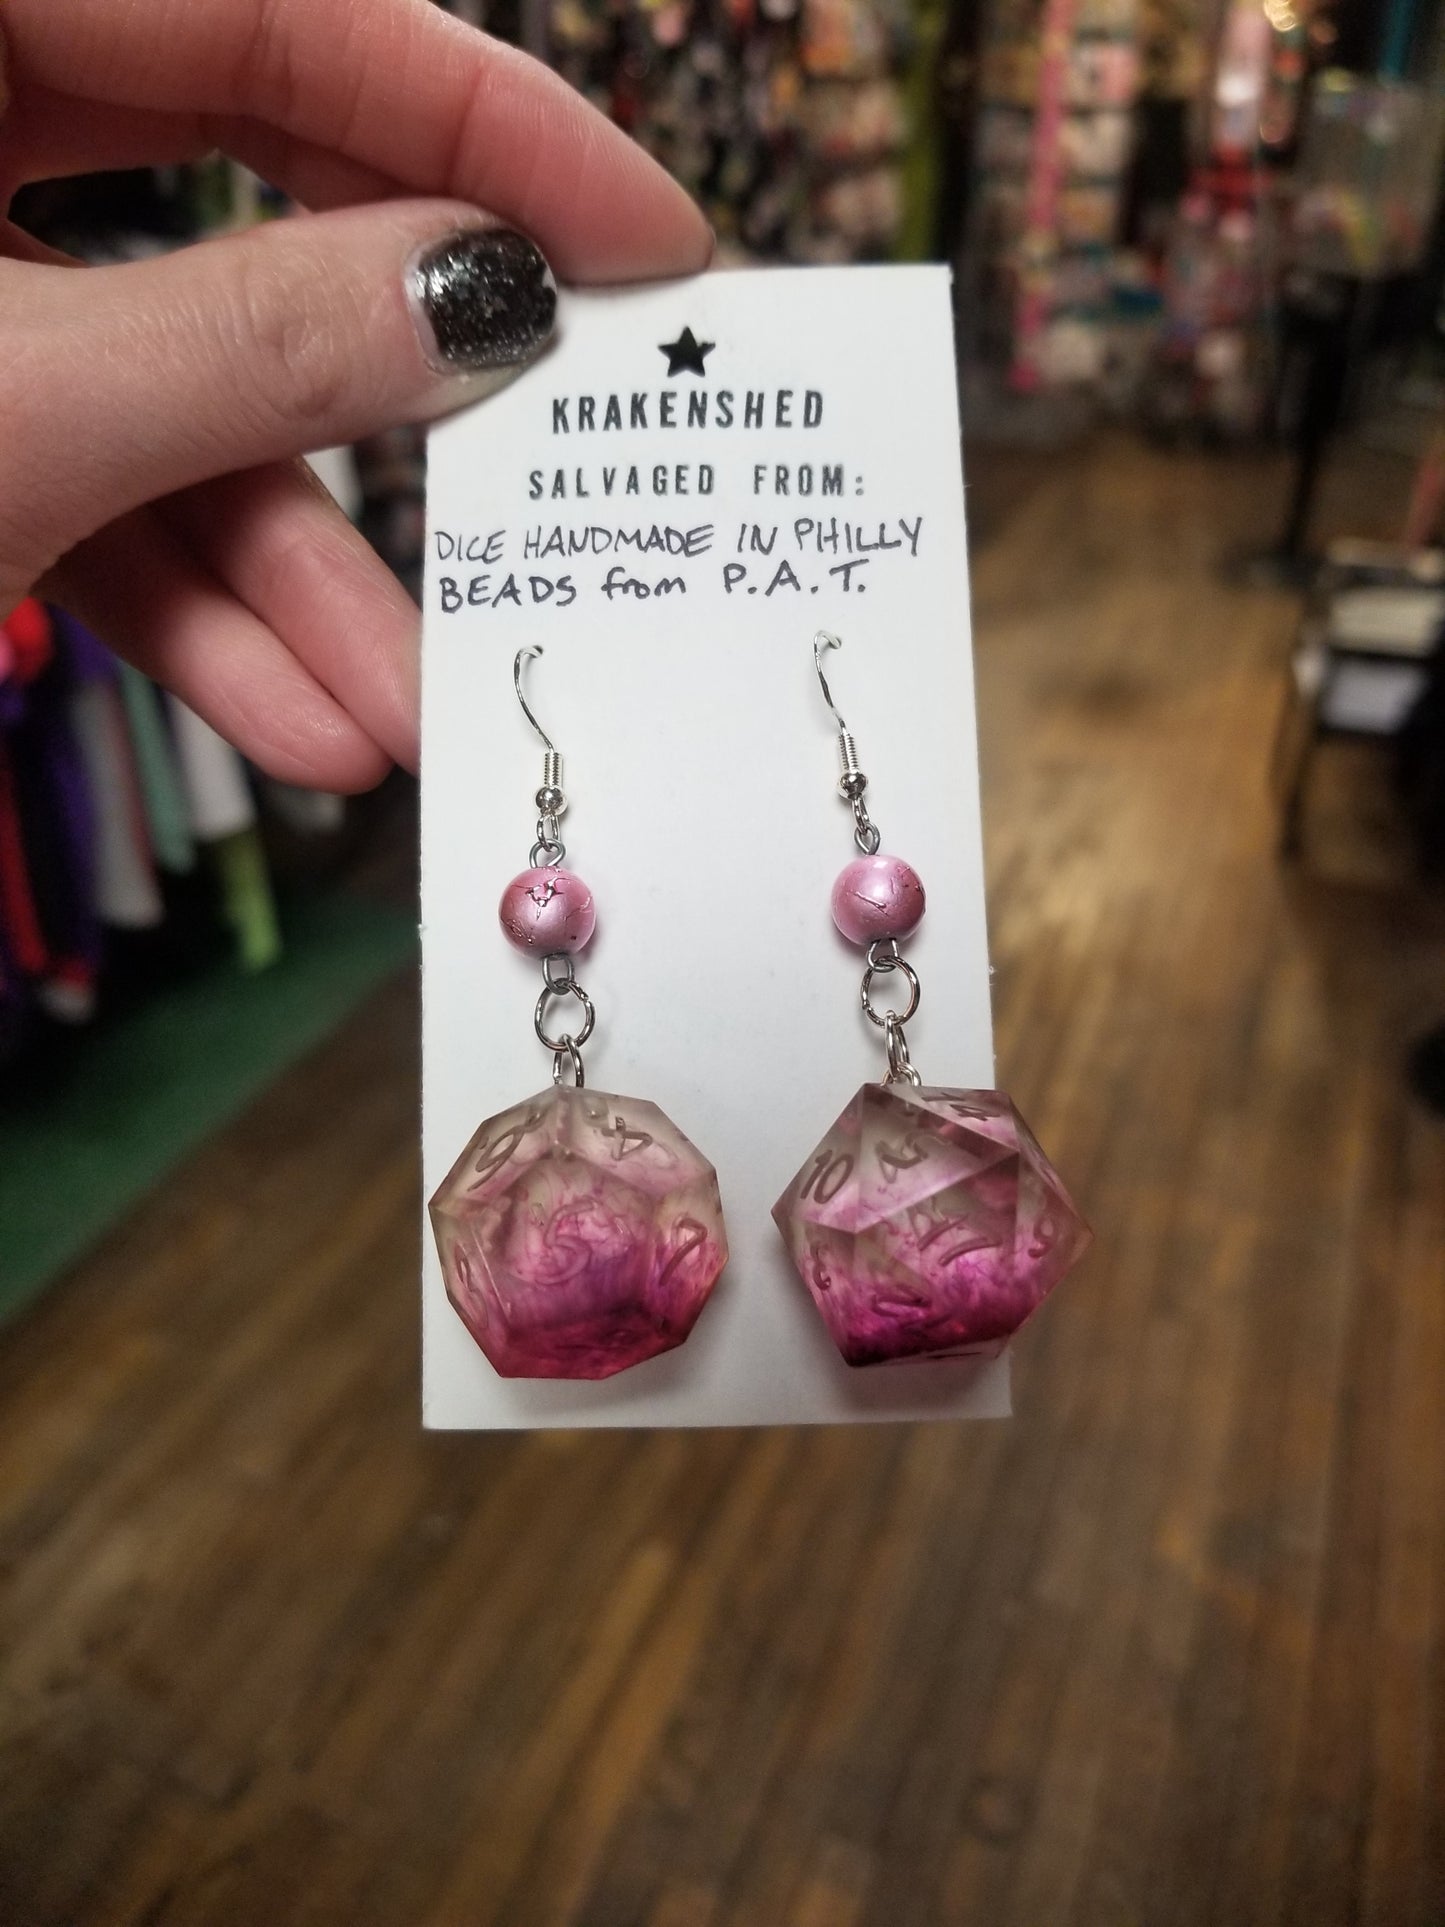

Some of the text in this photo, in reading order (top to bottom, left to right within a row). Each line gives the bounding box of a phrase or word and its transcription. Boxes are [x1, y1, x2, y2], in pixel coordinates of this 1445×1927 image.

[552, 389, 824, 434] KRAKENSHED
[528, 463, 866, 500] SALVAGED FROM:
[434, 516, 923, 564] DICE HANDMADE IN PHILLY
[439, 572, 577, 614] BEADS
[600, 565, 687, 601] from
[800, 1149, 854, 1204] 10
